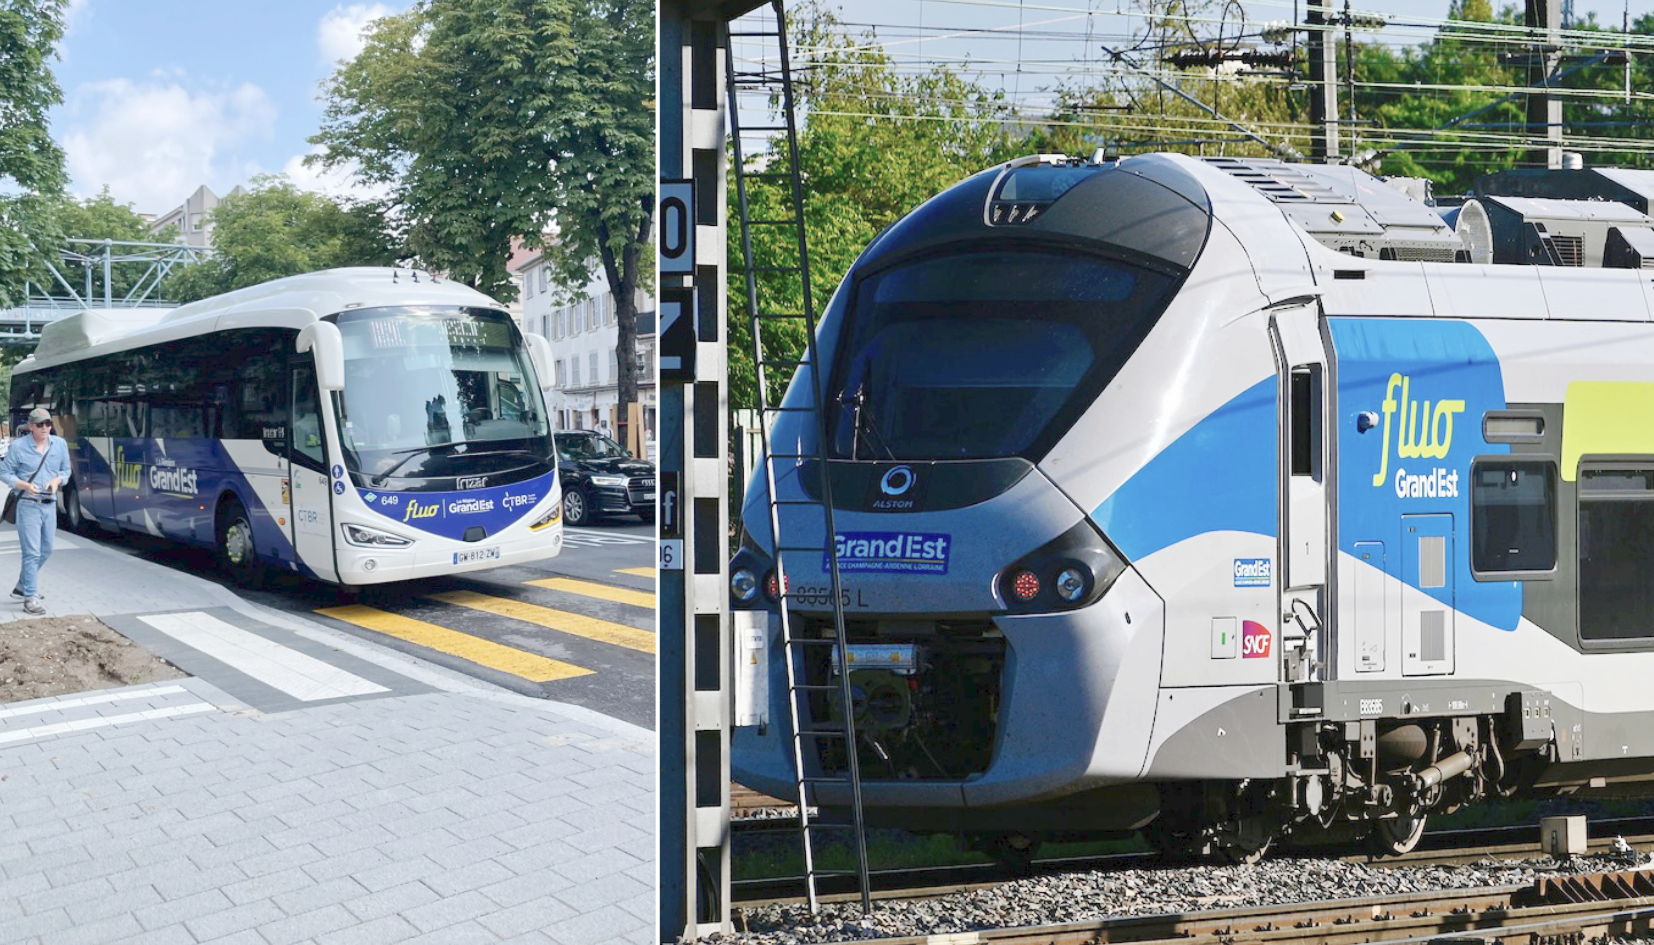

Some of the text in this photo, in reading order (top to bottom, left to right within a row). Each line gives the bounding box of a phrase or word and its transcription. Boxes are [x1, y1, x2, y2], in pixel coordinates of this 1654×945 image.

[1372, 372, 1465, 487] fluo
[115, 445, 142, 492] fluo
[381, 495, 399, 506] 649
[403, 499, 439, 522] fluo
[502, 494, 528, 508] CTBR
[873, 500, 913, 508] ALSTOM
[298, 509, 317, 523] CTBR
[797, 586, 869, 607] 8355 L
[1243, 634, 1270, 654] SNCF
